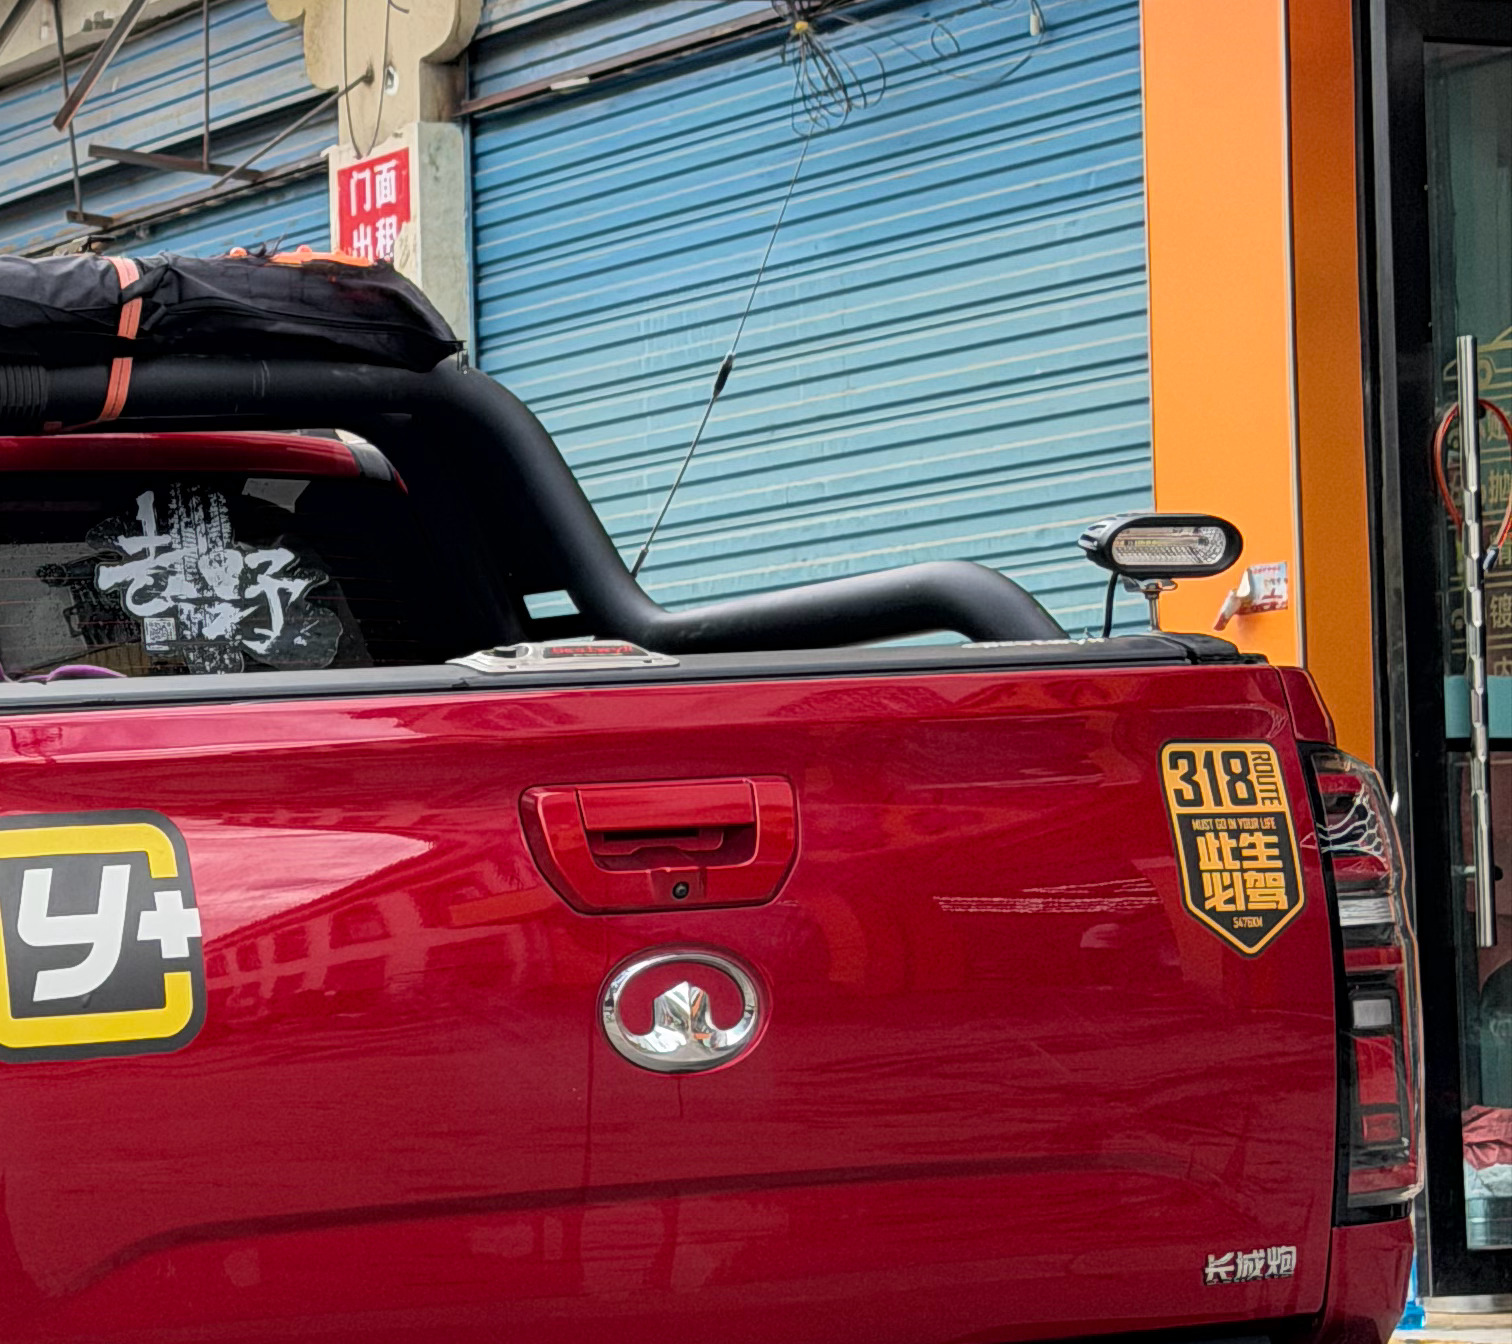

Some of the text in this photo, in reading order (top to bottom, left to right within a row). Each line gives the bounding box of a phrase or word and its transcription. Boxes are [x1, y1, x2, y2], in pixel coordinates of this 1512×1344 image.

[350, 159, 397, 216] 门面
[352, 214, 397, 263] 出租
[1168, 750, 1258, 808] 318
[1250, 750, 1282, 808] ROUTE
[1192, 818, 1214, 831] MUST
[1214, 818, 1228, 830] GO
[1196, 831, 1284, 870] 此生
[1202, 870, 1289, 912] 必驾
[1203, 1245, 1297, 1286] 长城炮
